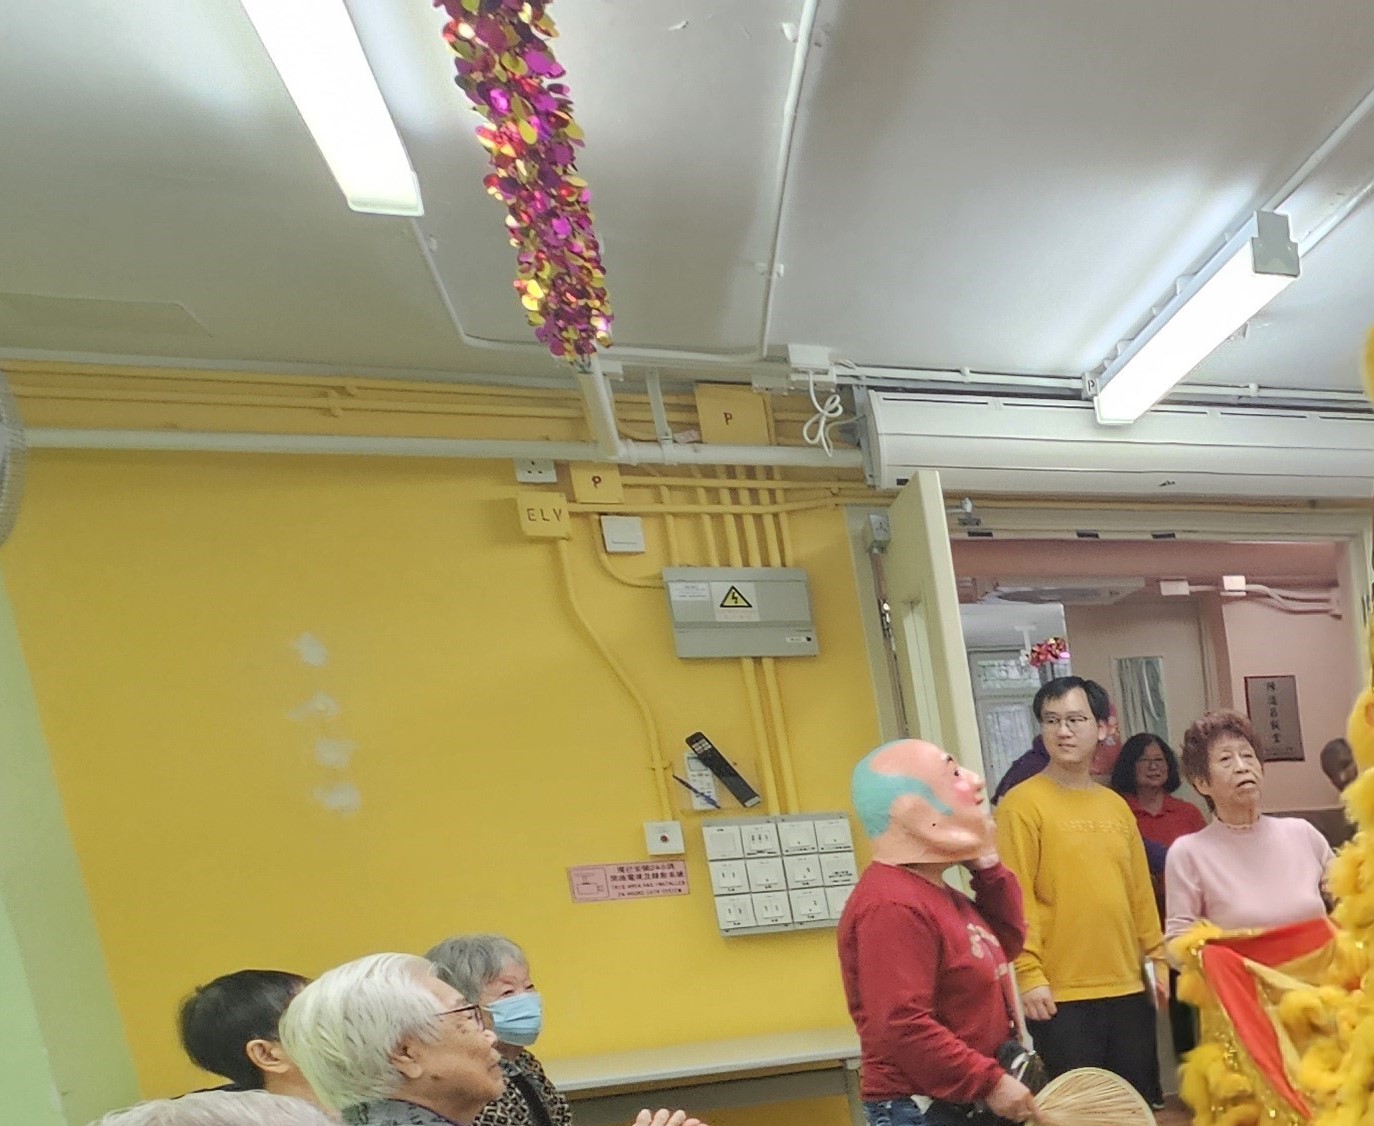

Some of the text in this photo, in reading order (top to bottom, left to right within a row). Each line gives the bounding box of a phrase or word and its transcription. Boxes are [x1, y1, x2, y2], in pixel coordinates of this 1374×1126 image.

[1088, 379, 1095, 391] P
[723, 412, 733, 425] P
[591, 475, 602, 488] P
